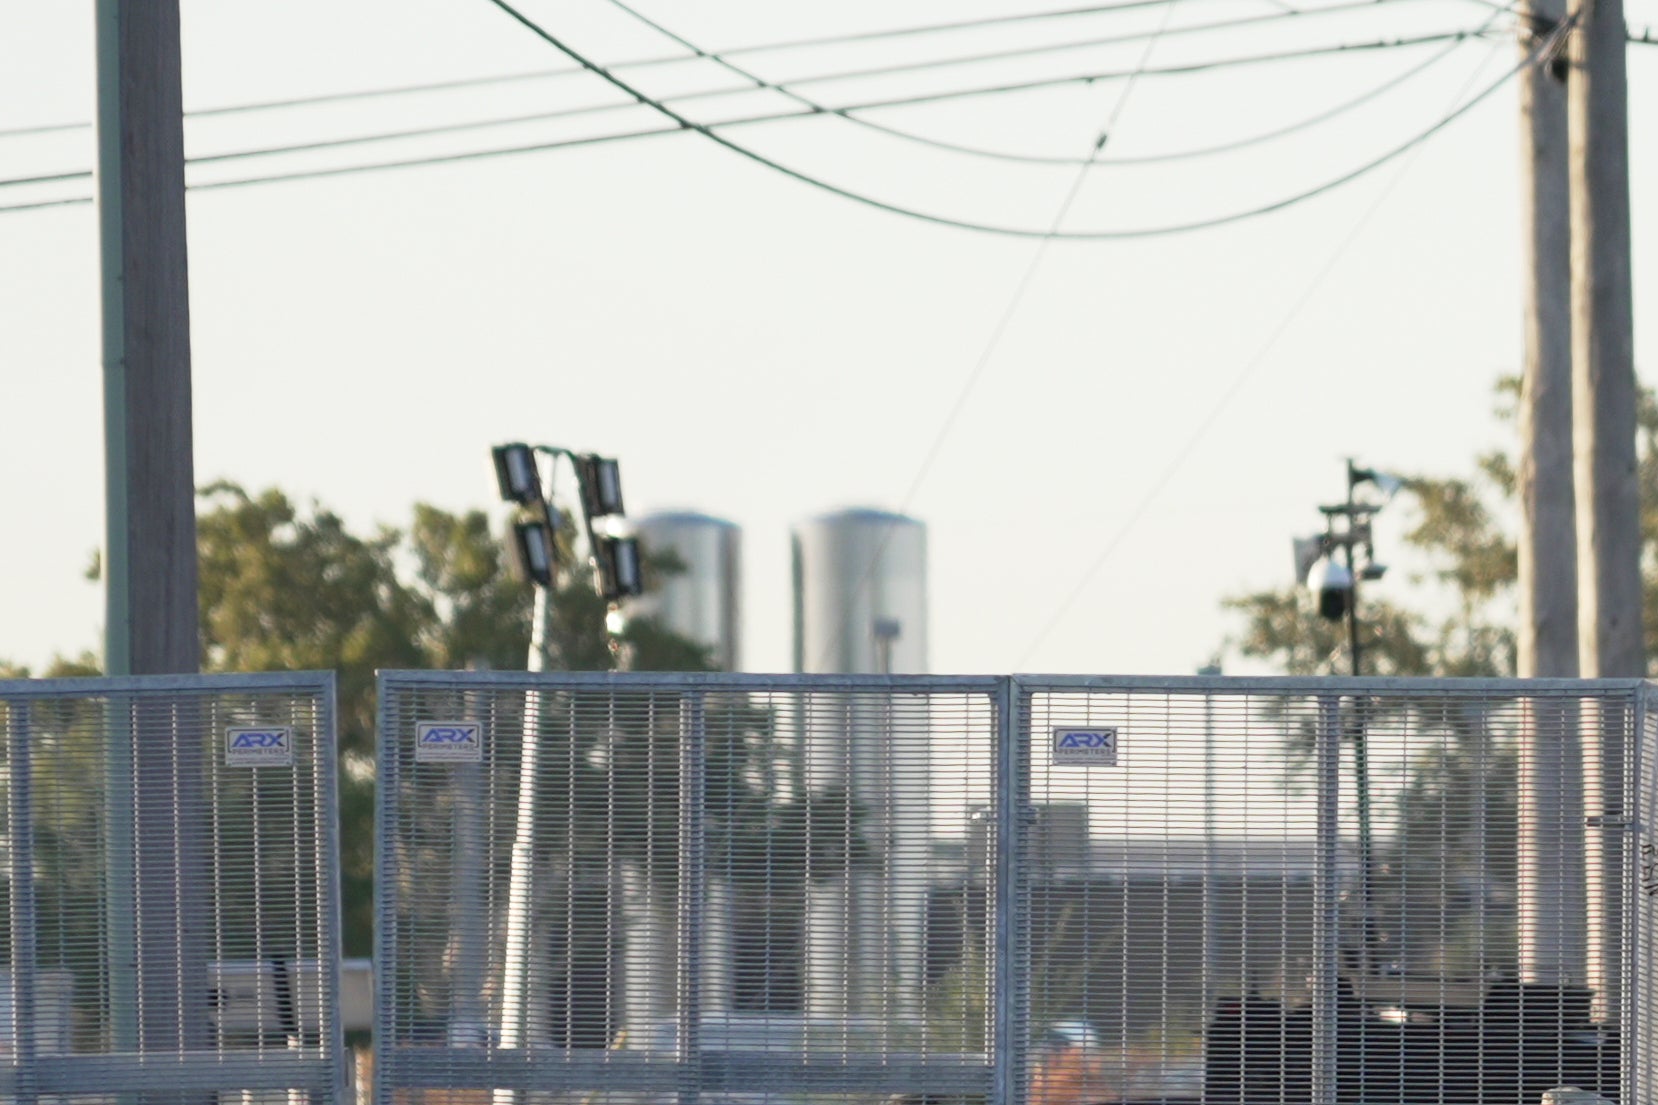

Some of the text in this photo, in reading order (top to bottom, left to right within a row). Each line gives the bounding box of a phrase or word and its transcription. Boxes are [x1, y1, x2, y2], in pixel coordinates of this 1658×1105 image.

[231, 733, 286, 748] ARX
[423, 728, 476, 743] ARX
[1058, 733, 1112, 748] ARX
